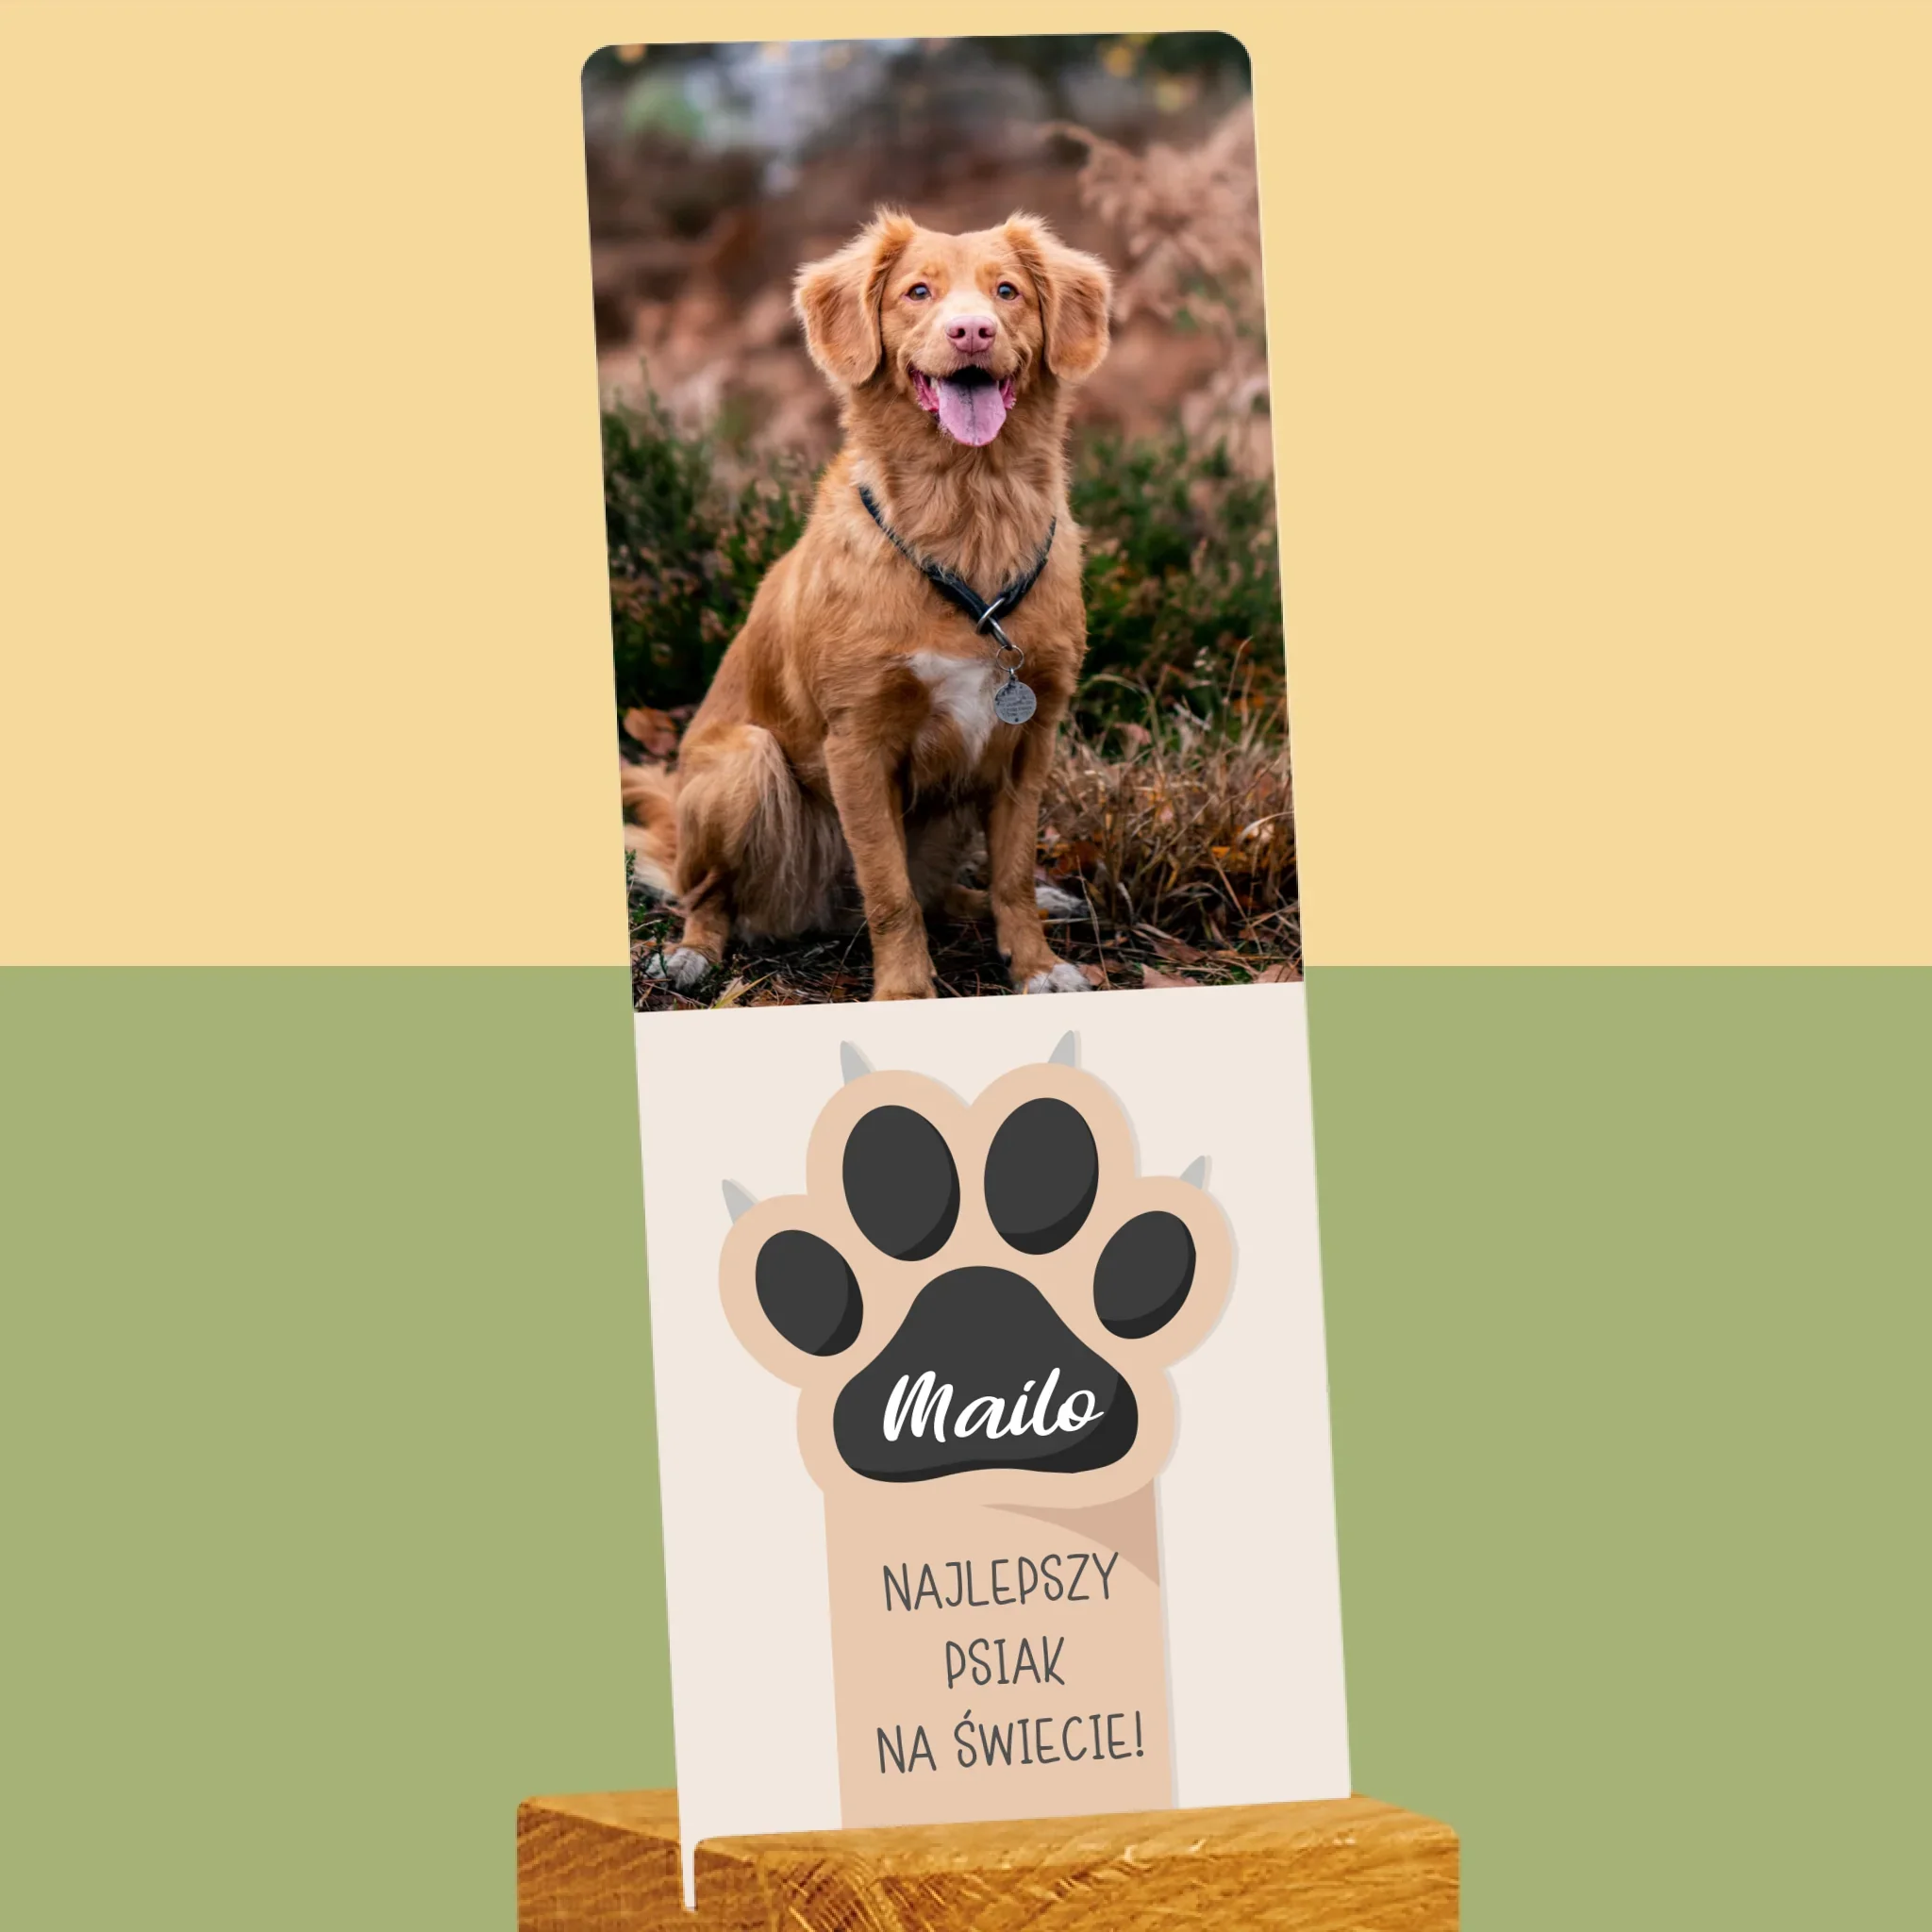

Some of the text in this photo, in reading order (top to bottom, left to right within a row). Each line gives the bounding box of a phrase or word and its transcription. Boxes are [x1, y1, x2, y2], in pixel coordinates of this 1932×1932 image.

[883, 1367, 1105, 1443] Mailo
[882, 1551, 1119, 1612] NAJLEPSZY
[945, 1635, 1065, 1690] PSIAK
[876, 1708, 1144, 1774] NA ŚWIECIE!
